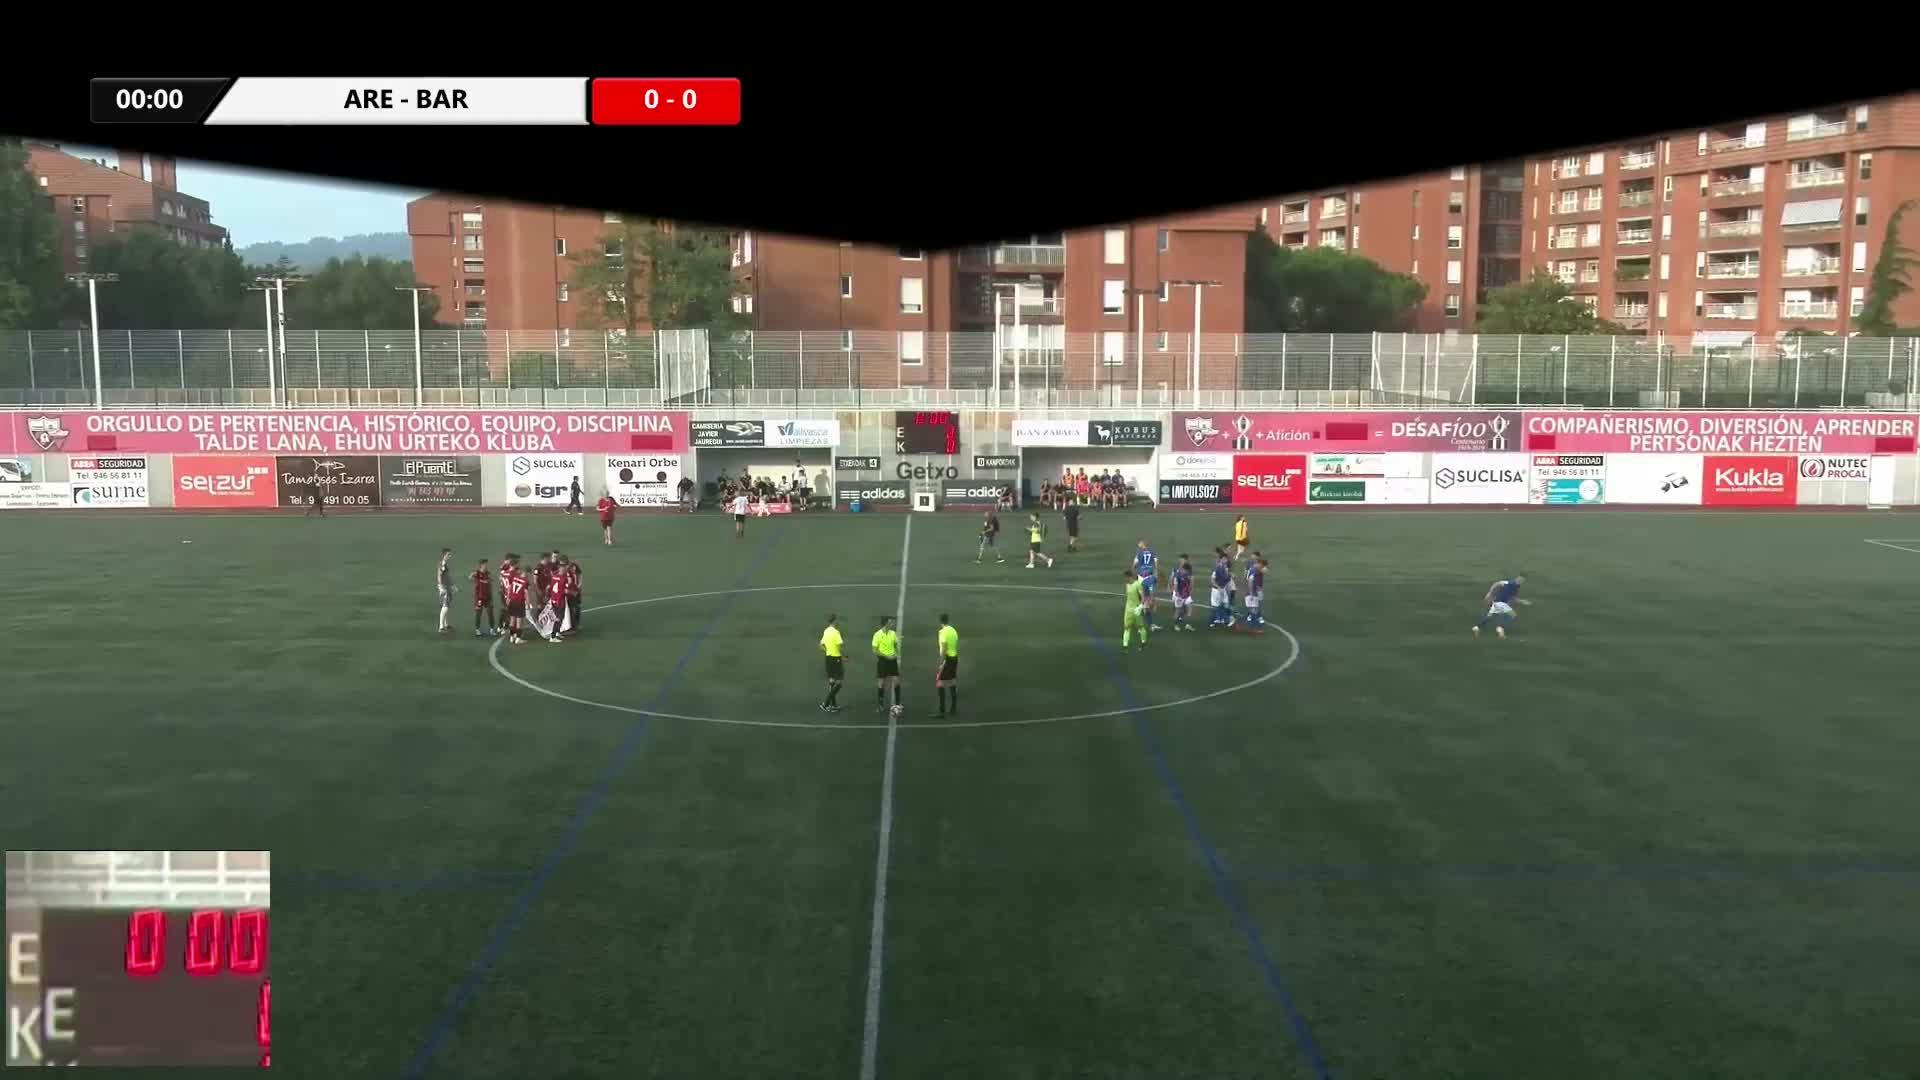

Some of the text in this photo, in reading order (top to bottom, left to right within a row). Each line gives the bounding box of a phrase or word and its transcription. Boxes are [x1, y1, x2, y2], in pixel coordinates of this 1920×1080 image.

[87, 412, 674, 434] ORGULLO DE PERTENENCIA, HISTÓRICO, EQUIPO, DISCIPLINA
[1529, 414, 1914, 437] COMPAÑERISMO, DIVERSIÓN, APRENDER
[896, 427, 905, 438] E
[1114, 426, 1157, 434] KOBUS
[1265, 429, 1311, 441] Afición
[196, 434, 556, 452] TALDE LANA, EHUN URTEKO KLUBA
[896, 441, 905, 453] K
[1630, 435, 1823, 452] PERTSONAK HEZTEN
[99, 460, 144, 468] SEGURIDAD
[533, 460, 575, 468] SUCLISA
[608, 458, 678, 468] Kenari Orbe
[1559, 457, 1601, 465] SEGURIDAD
[1828, 459, 1868, 468] NUTEC
[896, 461, 959, 480] Getxo
[1456, 470, 1523, 483] SUCLISA
[1715, 467, 1784, 486] Kukla
[1827, 470, 1867, 478] PROCAL
[339, 472, 376, 485] Izarra
[92, 486, 146, 498] surne
[535, 484, 568, 498] igr
[861, 487, 906, 499] adidas
[323, 495, 339, 505] 491
[343, 495, 355, 505] 00
[357, 495, 370, 505] 05
[10, 933, 40, 984] E
[10, 1007, 43, 1061] K
